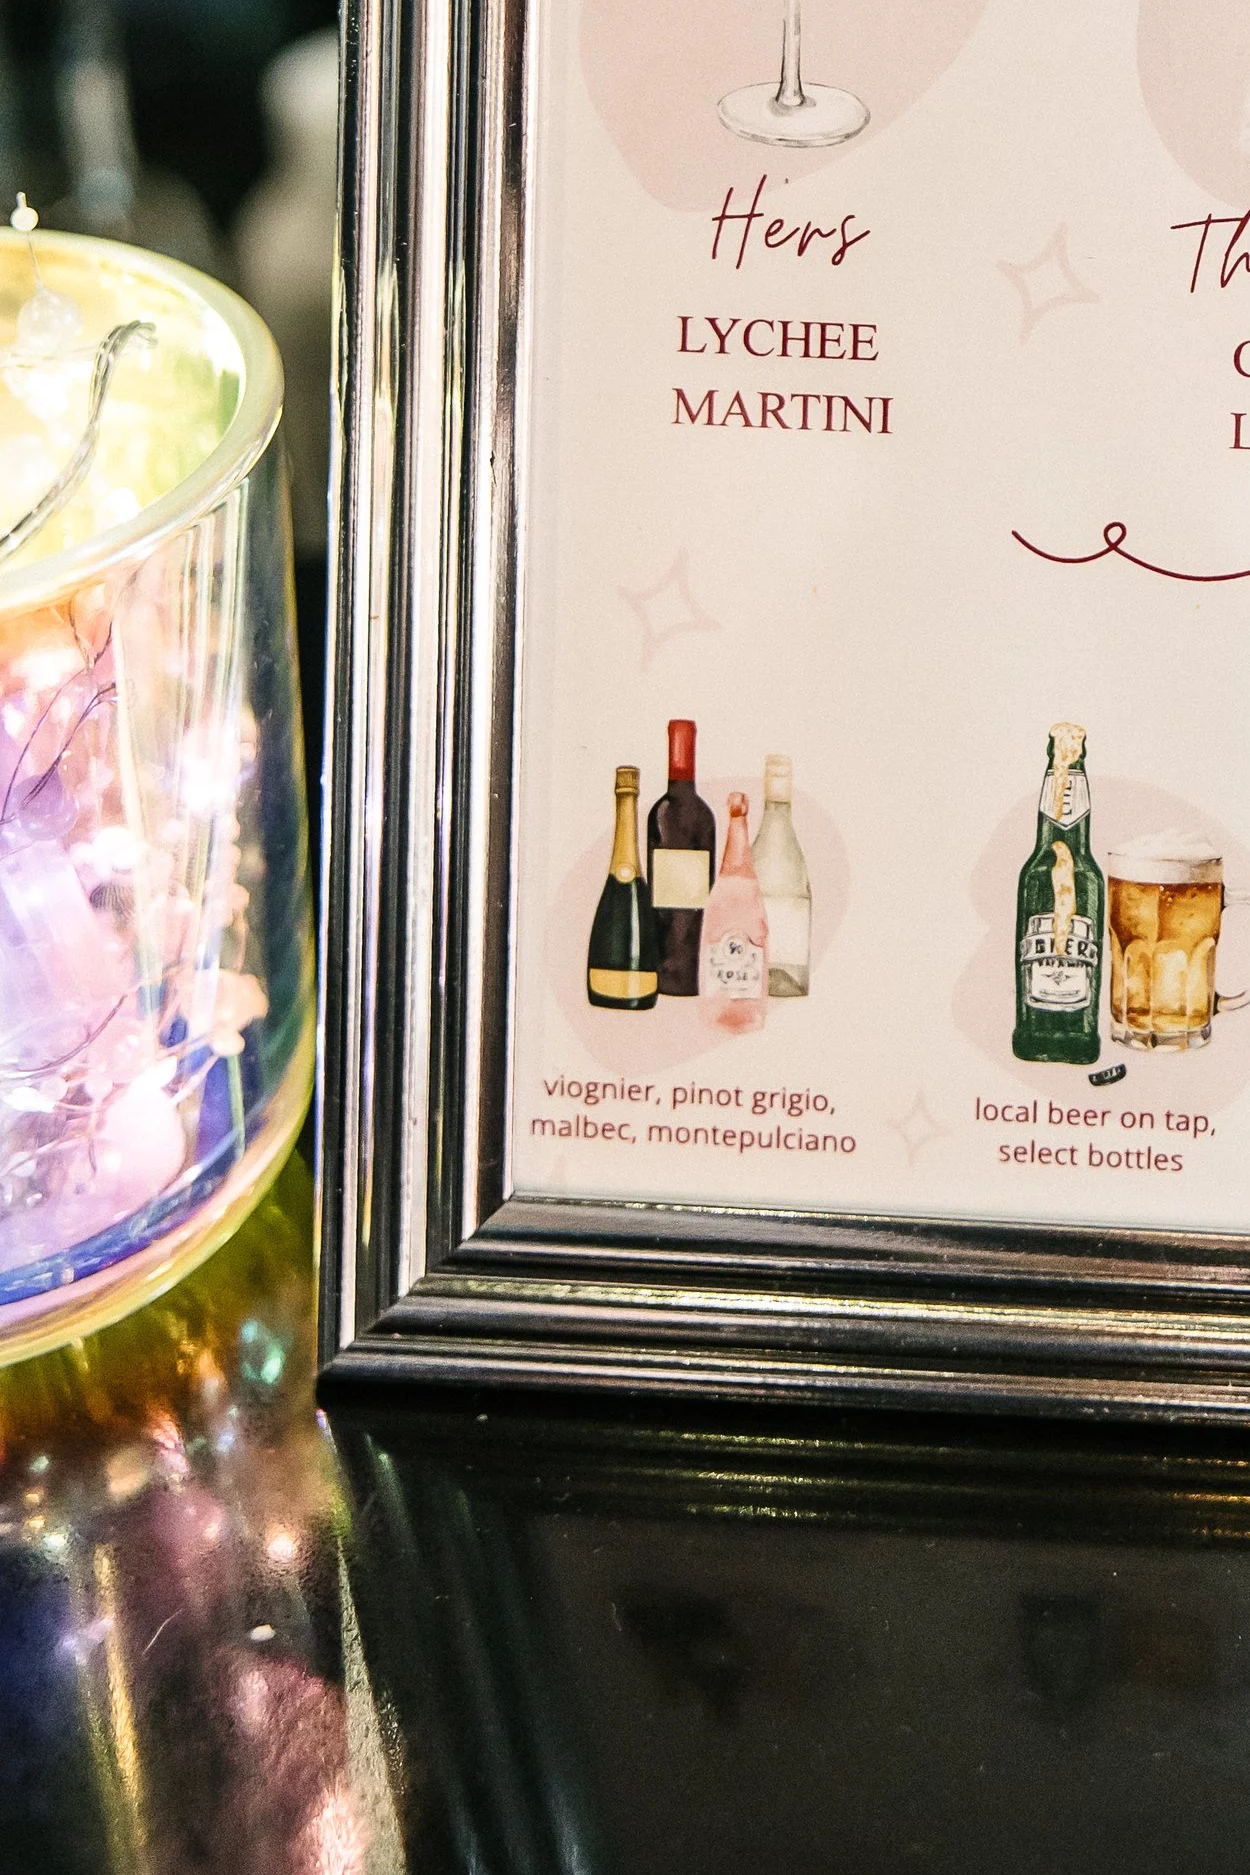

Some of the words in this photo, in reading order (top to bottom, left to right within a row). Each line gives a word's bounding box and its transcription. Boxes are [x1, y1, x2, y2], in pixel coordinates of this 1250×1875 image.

[711, 174, 871, 270] Hers
[677, 315, 879, 361] LYCHEE
[672, 387, 894, 434] MARTINI
[543, 1080, 661, 1106] viognier,
[672, 1087, 743, 1110] pinot
[751, 1091, 835, 1117] grigio,
[975, 1097, 1038, 1124] local
[1048, 1101, 1112, 1127] beer
[1120, 1111, 1155, 1129] on
[1164, 1110, 1216, 1139] tap,
[531, 1114, 637, 1144] malbec,
[648, 1125, 857, 1154] montepulciano
[999, 1139, 1078, 1166] select
[1088, 1143, 1183, 1172] bottles
